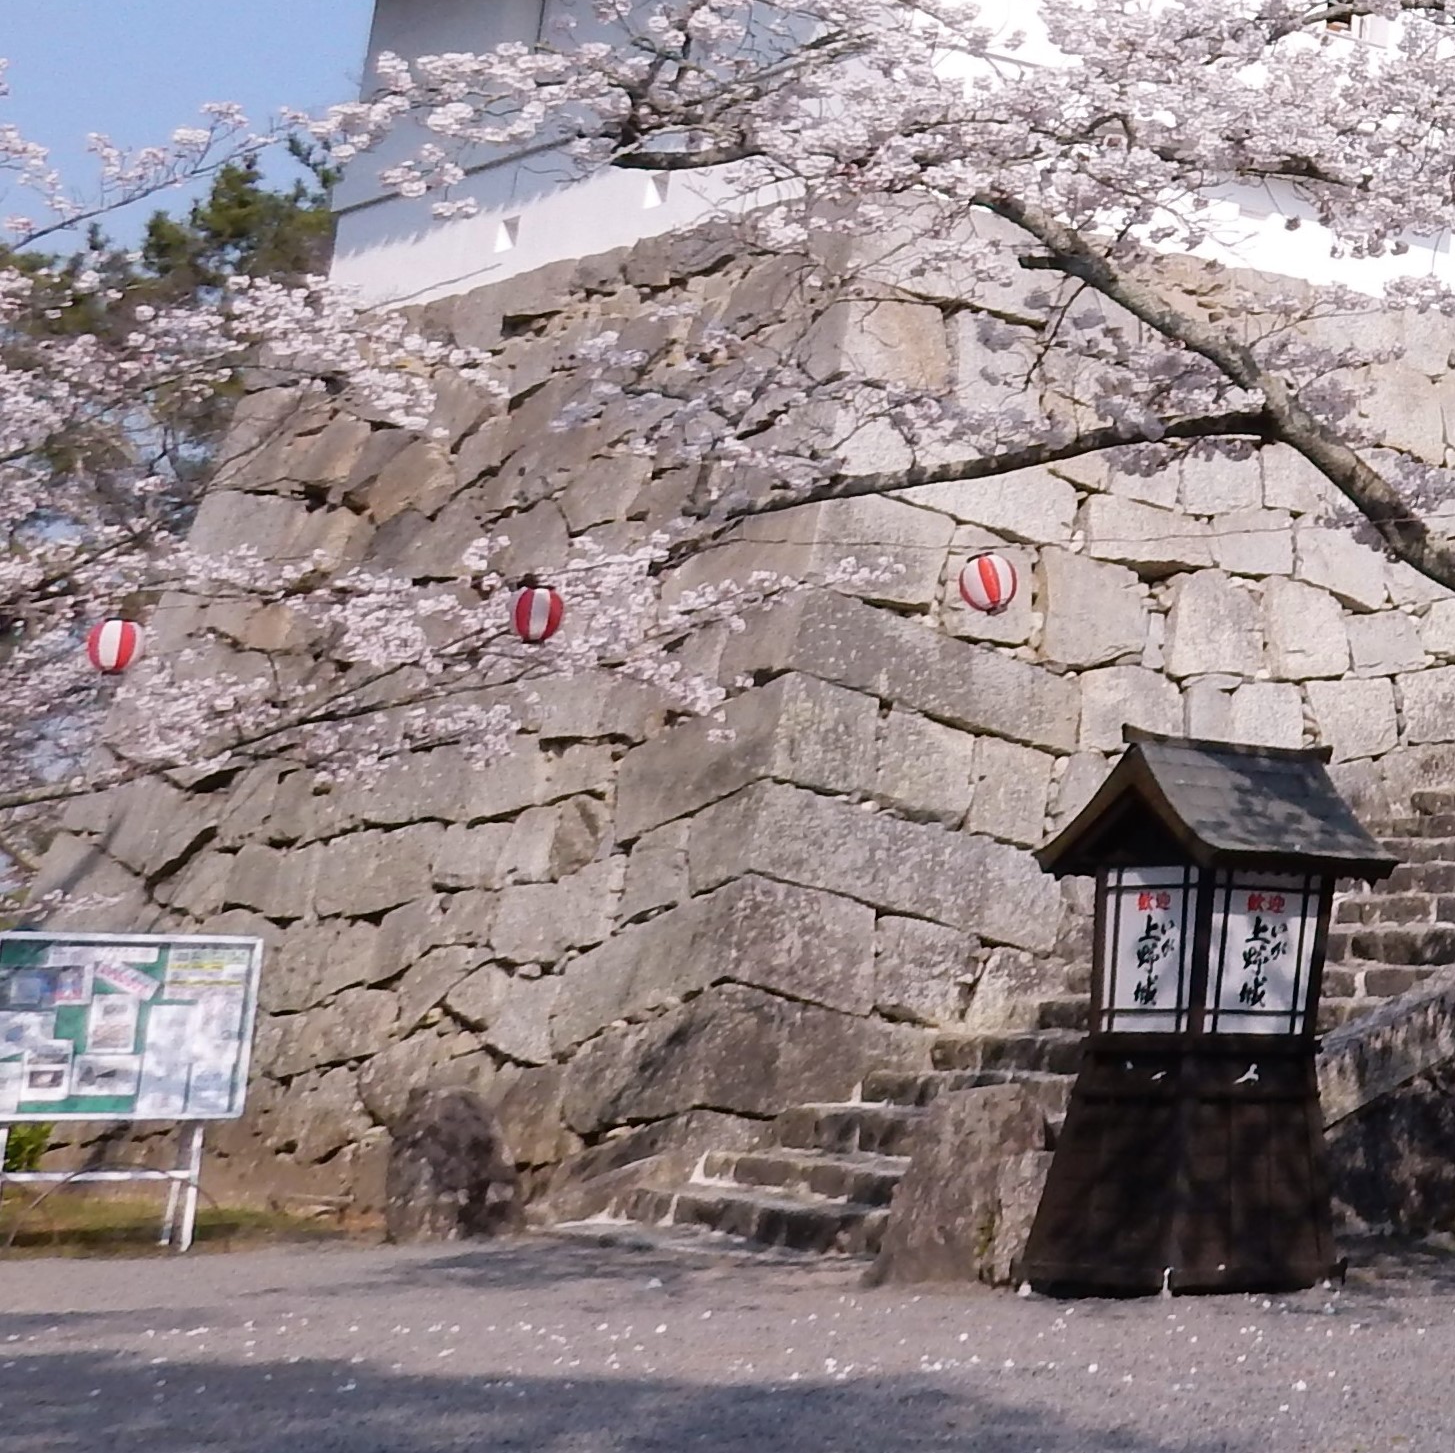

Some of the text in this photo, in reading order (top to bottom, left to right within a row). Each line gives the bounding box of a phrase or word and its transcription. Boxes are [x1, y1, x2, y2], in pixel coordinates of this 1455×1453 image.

[1133, 914, 1161, 1006] 上野城
[1239, 916, 1271, 1007] 上野城
